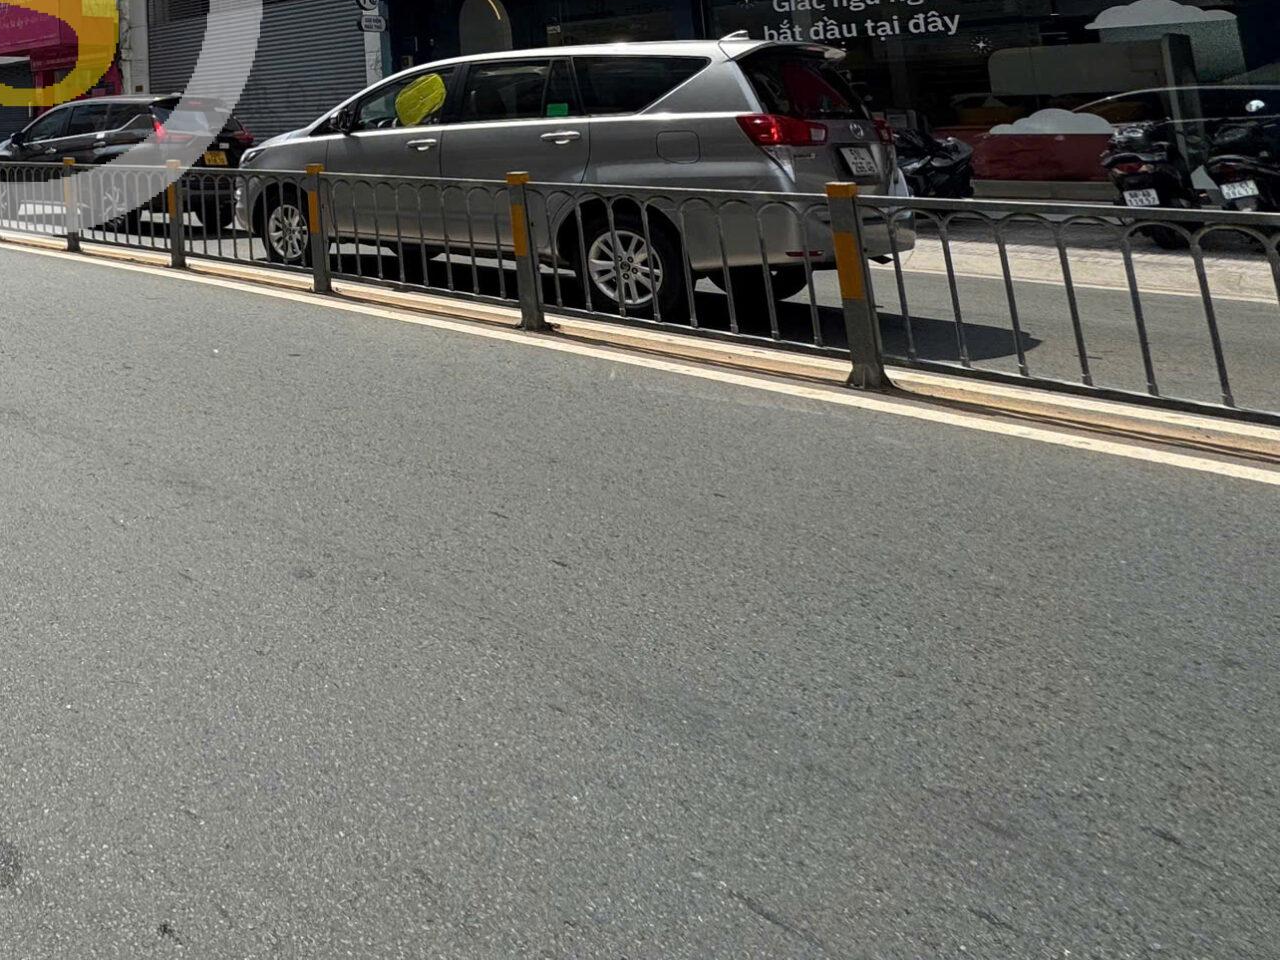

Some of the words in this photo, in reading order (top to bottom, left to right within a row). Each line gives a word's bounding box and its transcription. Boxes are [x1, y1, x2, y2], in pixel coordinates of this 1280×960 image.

[809, 16, 857, 41] đầu
[865, 15, 901, 41] tại
[908, 10, 961, 35] đây
